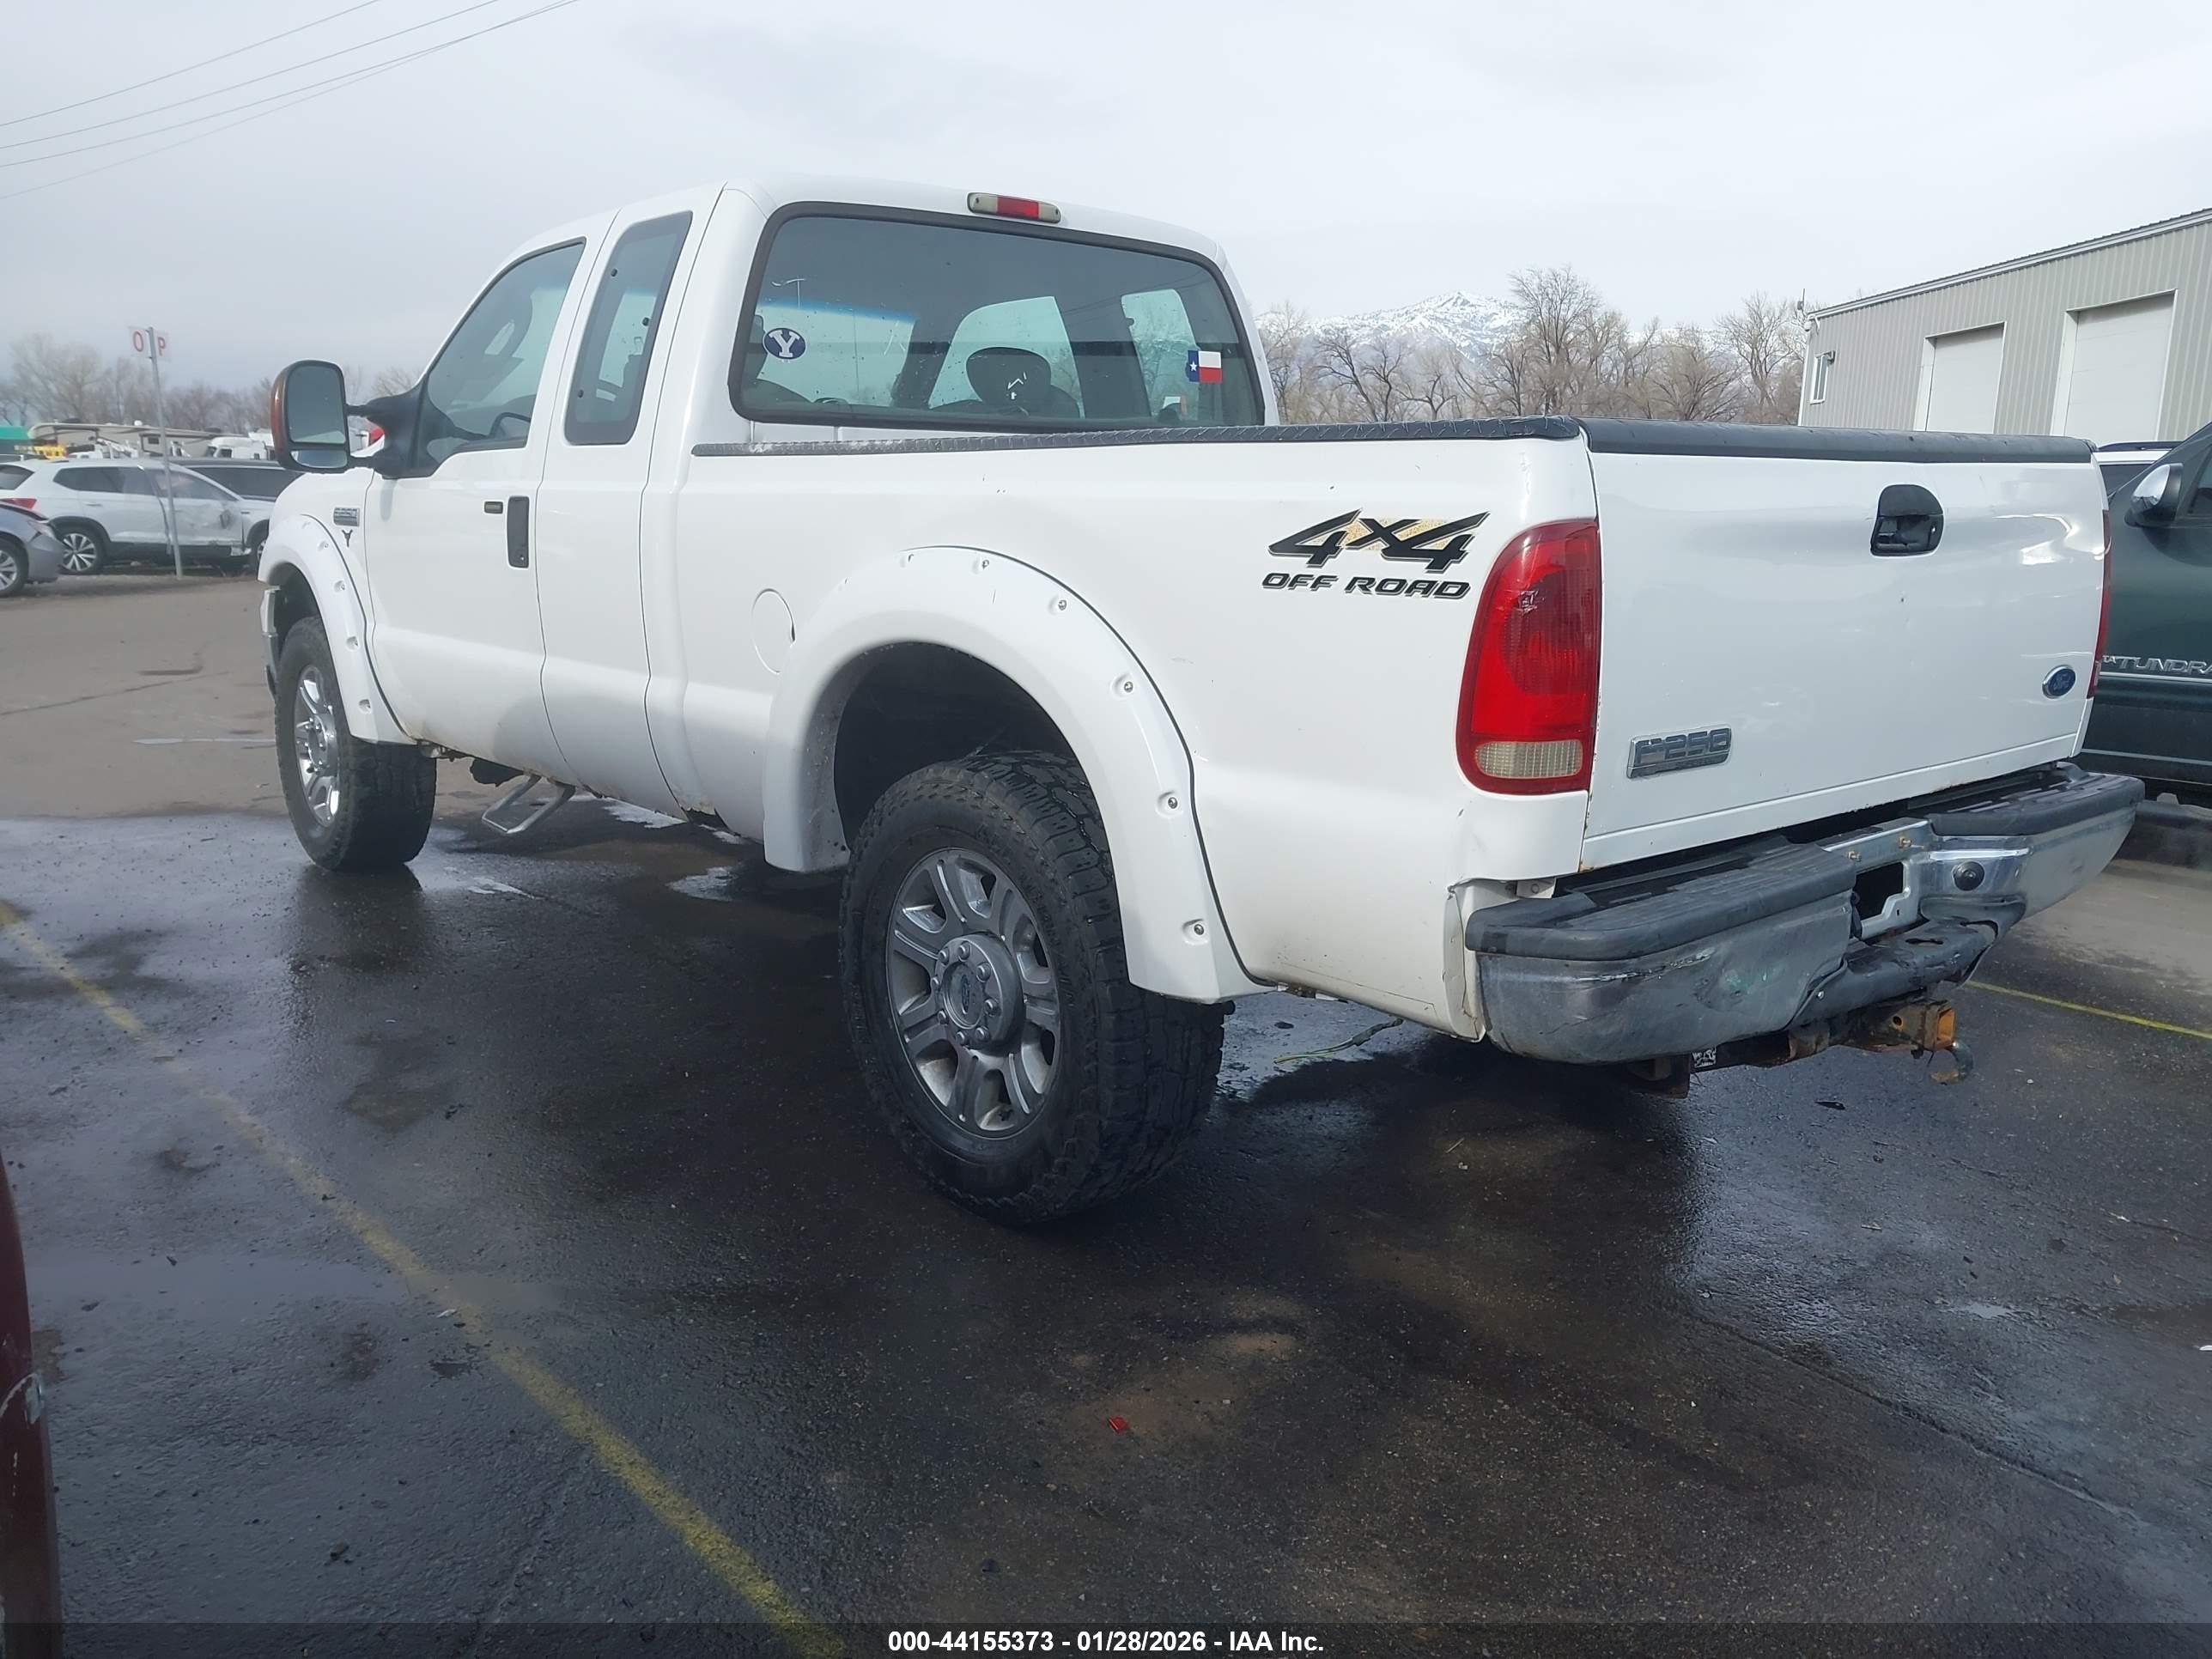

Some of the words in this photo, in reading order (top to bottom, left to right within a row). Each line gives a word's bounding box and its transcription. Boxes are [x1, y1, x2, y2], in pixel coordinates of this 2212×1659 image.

[157, 336, 166, 356] P
[769, 329, 800, 358] Y
[1261, 572, 1339, 591] OFF
[1345, 576, 1471, 600] ROAD
